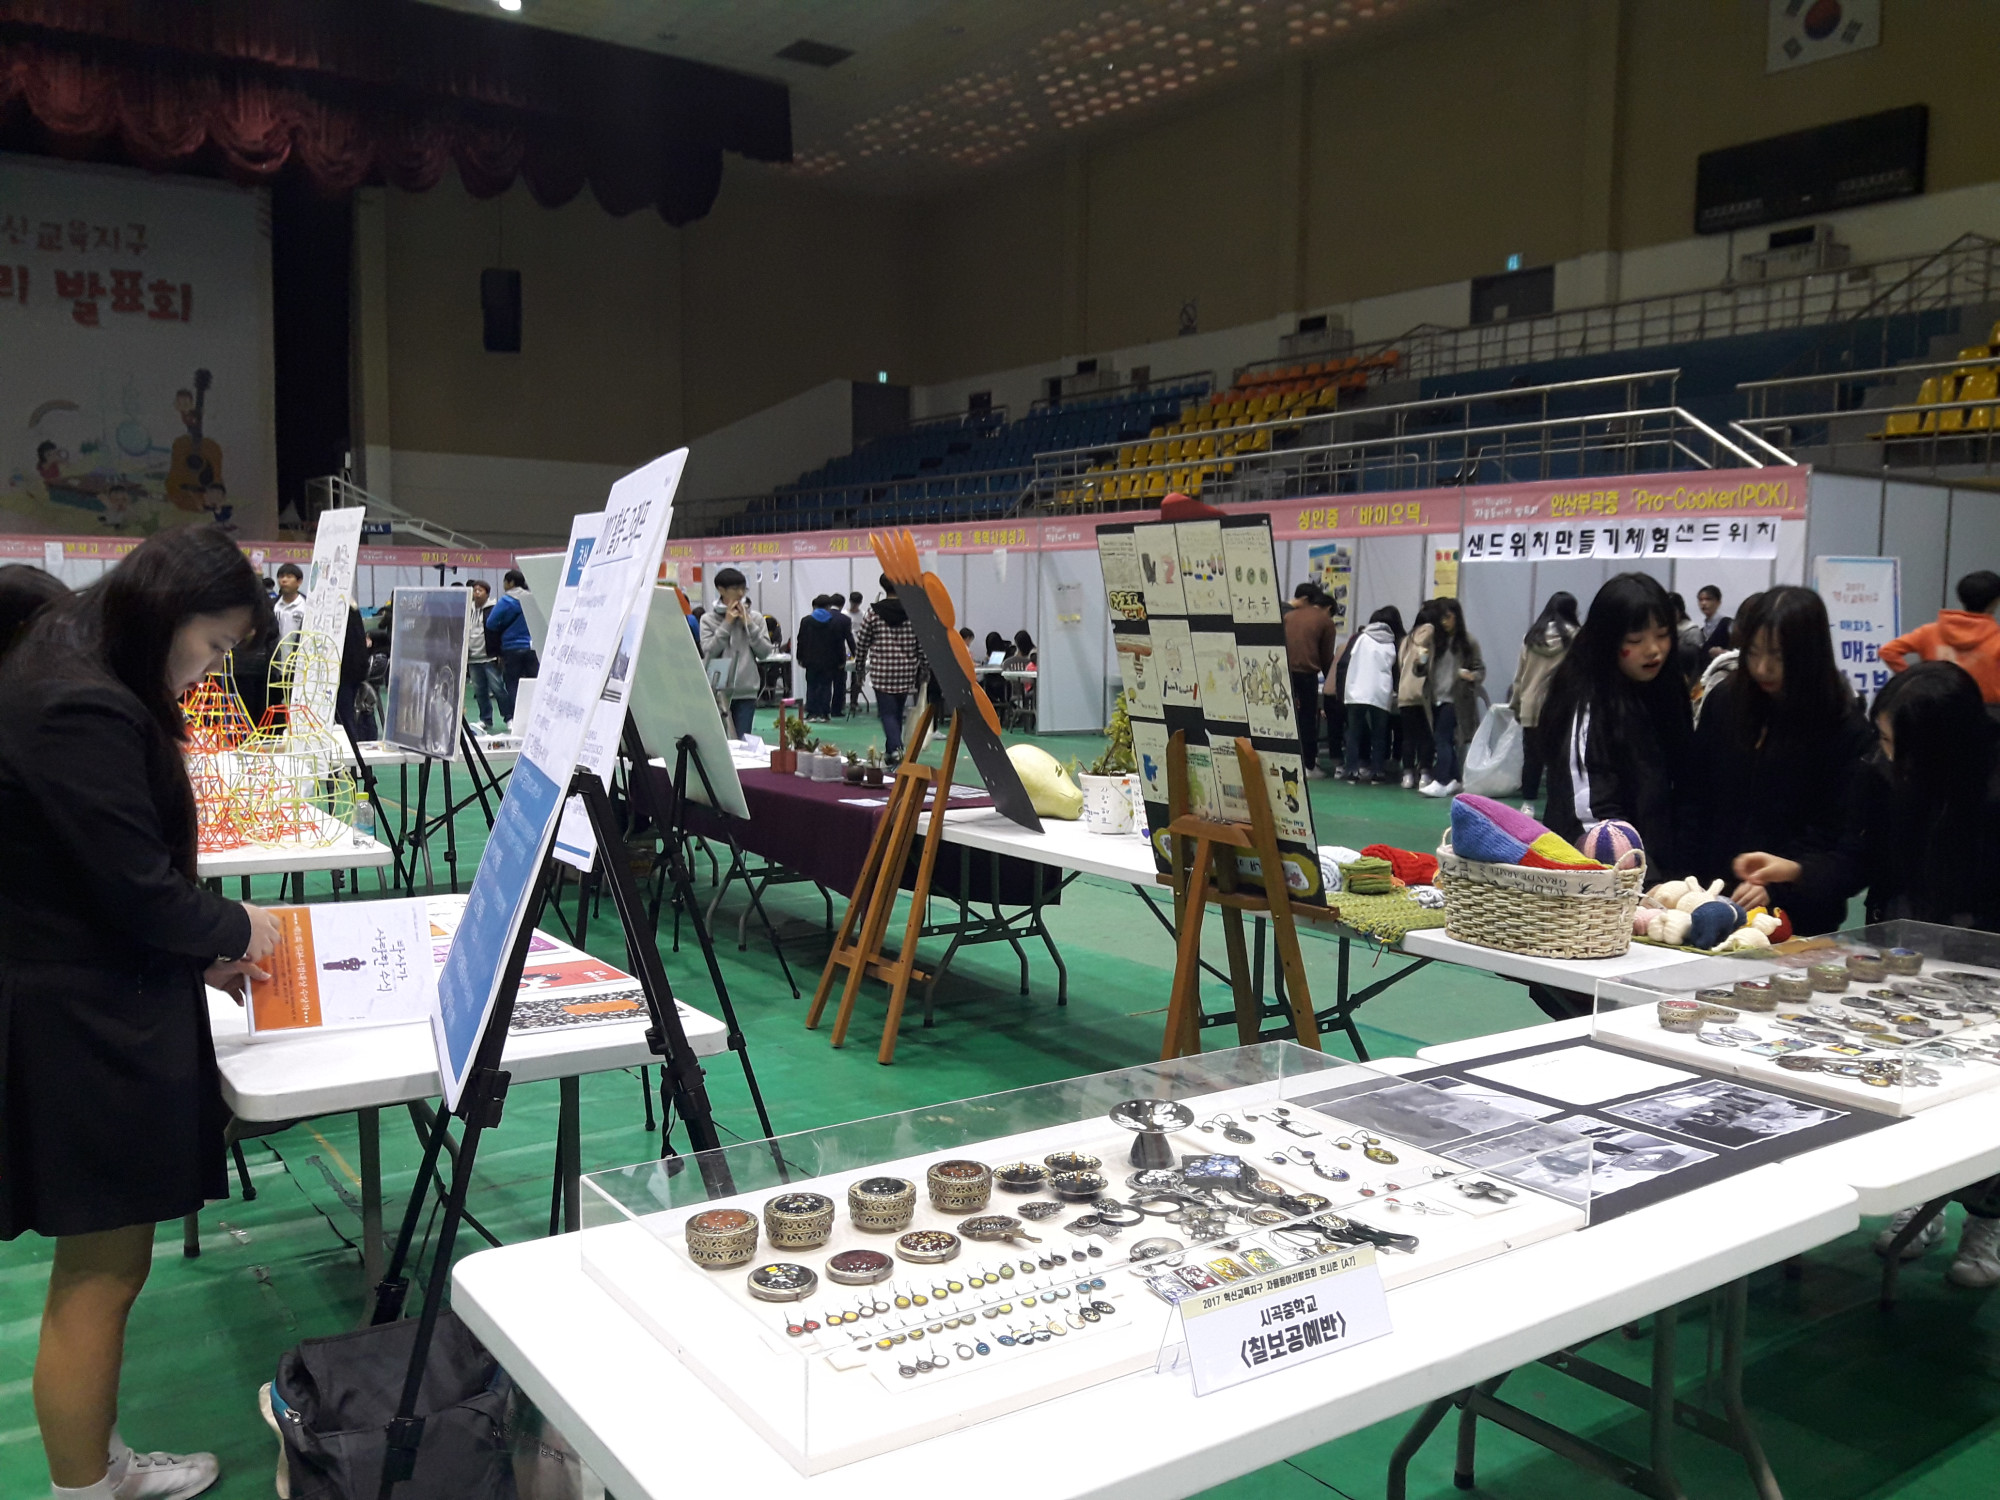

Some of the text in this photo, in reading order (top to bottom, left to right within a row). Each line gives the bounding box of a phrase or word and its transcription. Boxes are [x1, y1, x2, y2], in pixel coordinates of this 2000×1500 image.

[54, 269, 194, 328] 발표회
[371, 927, 393, 992] 사랑한 수식
[389, 940, 409, 981] 박사가
[1203, 1296, 1221, 1310] 2017
[1223, 1282, 1263, 1302] 혁신교육지구
[1320, 1262, 1339, 1276] 전시존
[1341, 1256, 1356, 1269] [A7]
[1260, 1294, 1319, 1328] 시곡중학교
